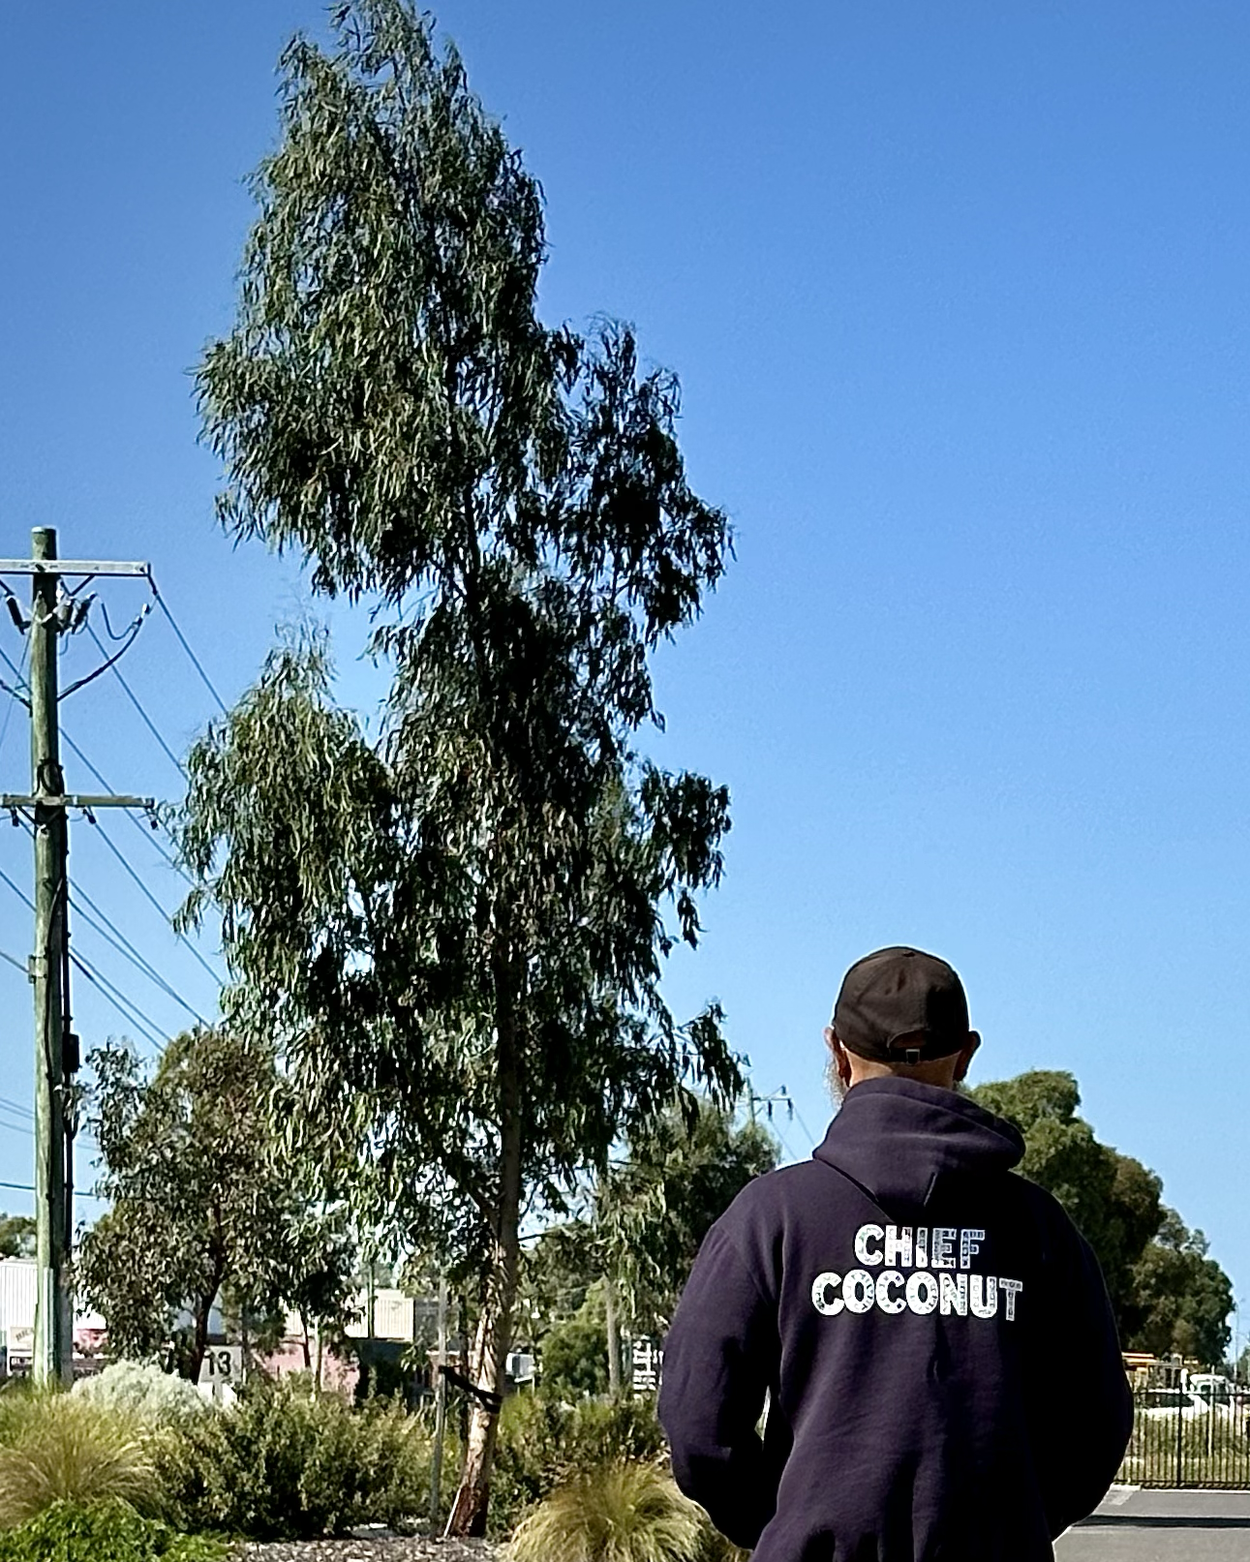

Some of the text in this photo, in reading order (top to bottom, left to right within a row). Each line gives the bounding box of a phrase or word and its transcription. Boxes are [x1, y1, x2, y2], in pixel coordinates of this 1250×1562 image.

[854, 1223, 986, 1269] CHIEF
[811, 1269, 1023, 1321] COCONUT
[204, 1350, 231, 1376] 13
